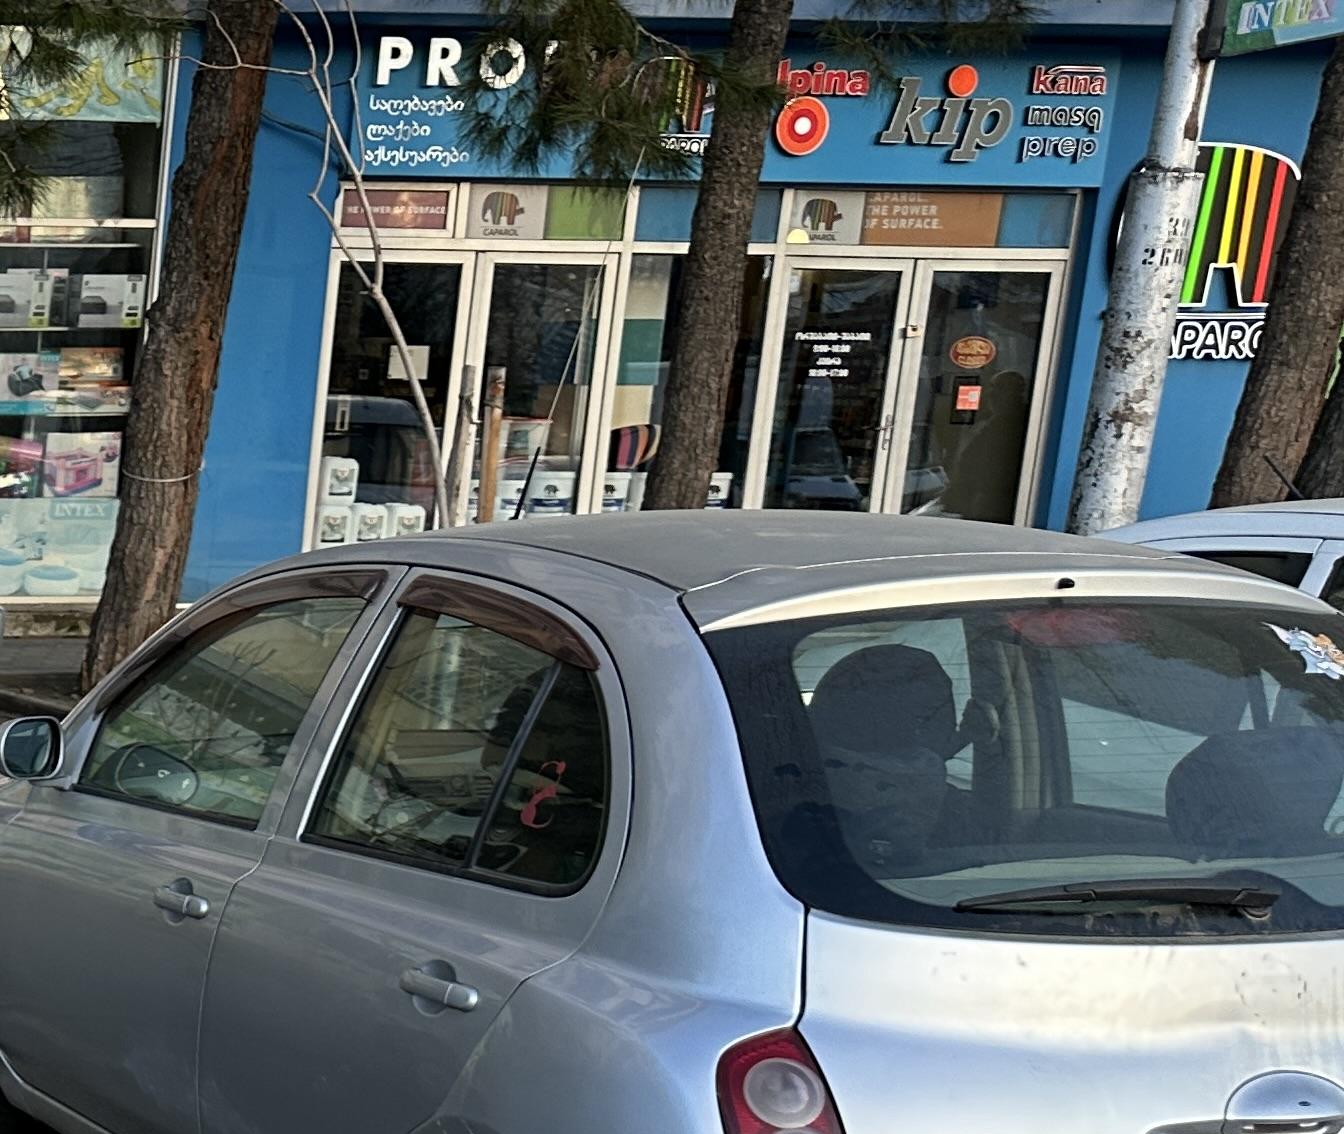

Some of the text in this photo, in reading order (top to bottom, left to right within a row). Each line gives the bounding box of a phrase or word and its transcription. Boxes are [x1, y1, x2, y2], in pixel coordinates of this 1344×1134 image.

[376, 36, 559, 90] PRO
[1032, 65, 1108, 95] kana
[369, 94, 465, 116] საღებავები
[880, 64, 1014, 162] kip
[366, 120, 431, 141] ლაქები
[1027, 104, 1104, 133] masq
[365, 145, 470, 167] აქსესუარები
[1022, 135, 1099, 163] prep
[893, 204, 938, 217] POWER
[55, 501, 105, 517] INTEX
